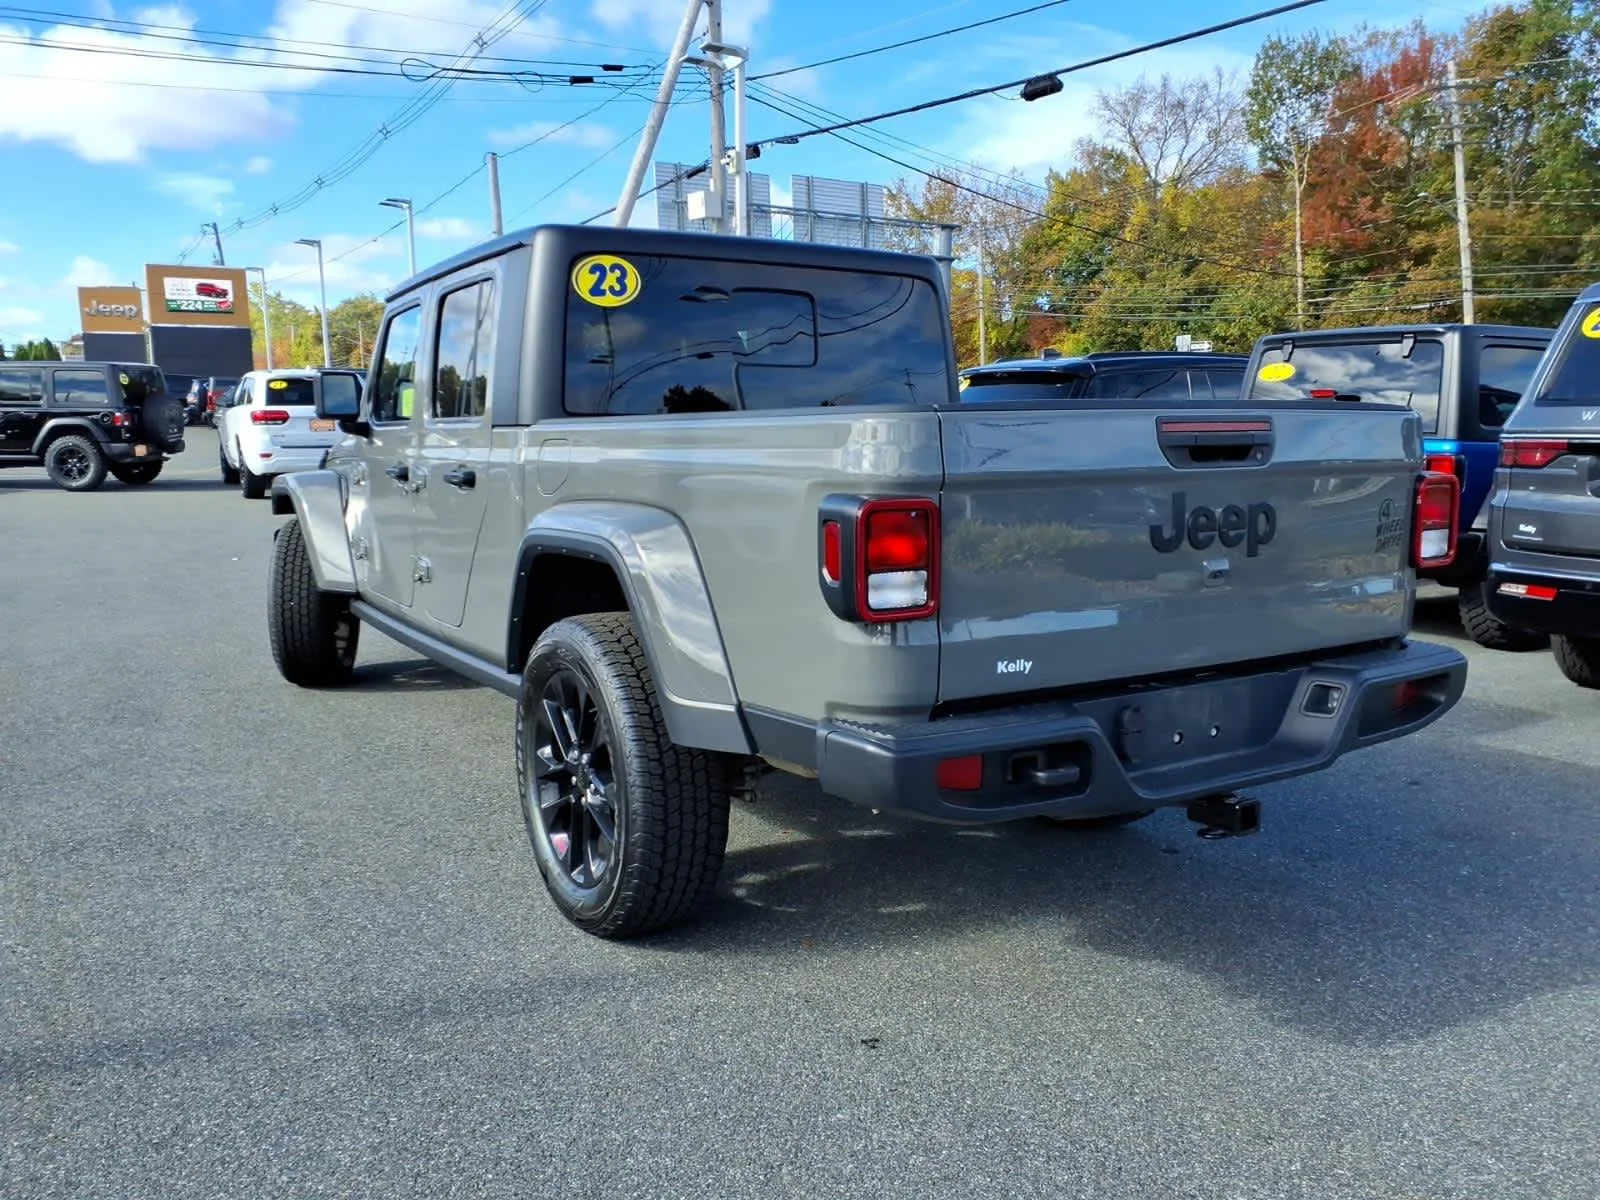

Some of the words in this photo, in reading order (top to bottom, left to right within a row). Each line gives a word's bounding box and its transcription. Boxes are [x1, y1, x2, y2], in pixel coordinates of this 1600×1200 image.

[588, 263, 628, 297] 23
[84, 300, 137, 319] Jeep
[1149, 491, 1277, 558] Jeep
[996, 659, 1033, 674] Kelly
